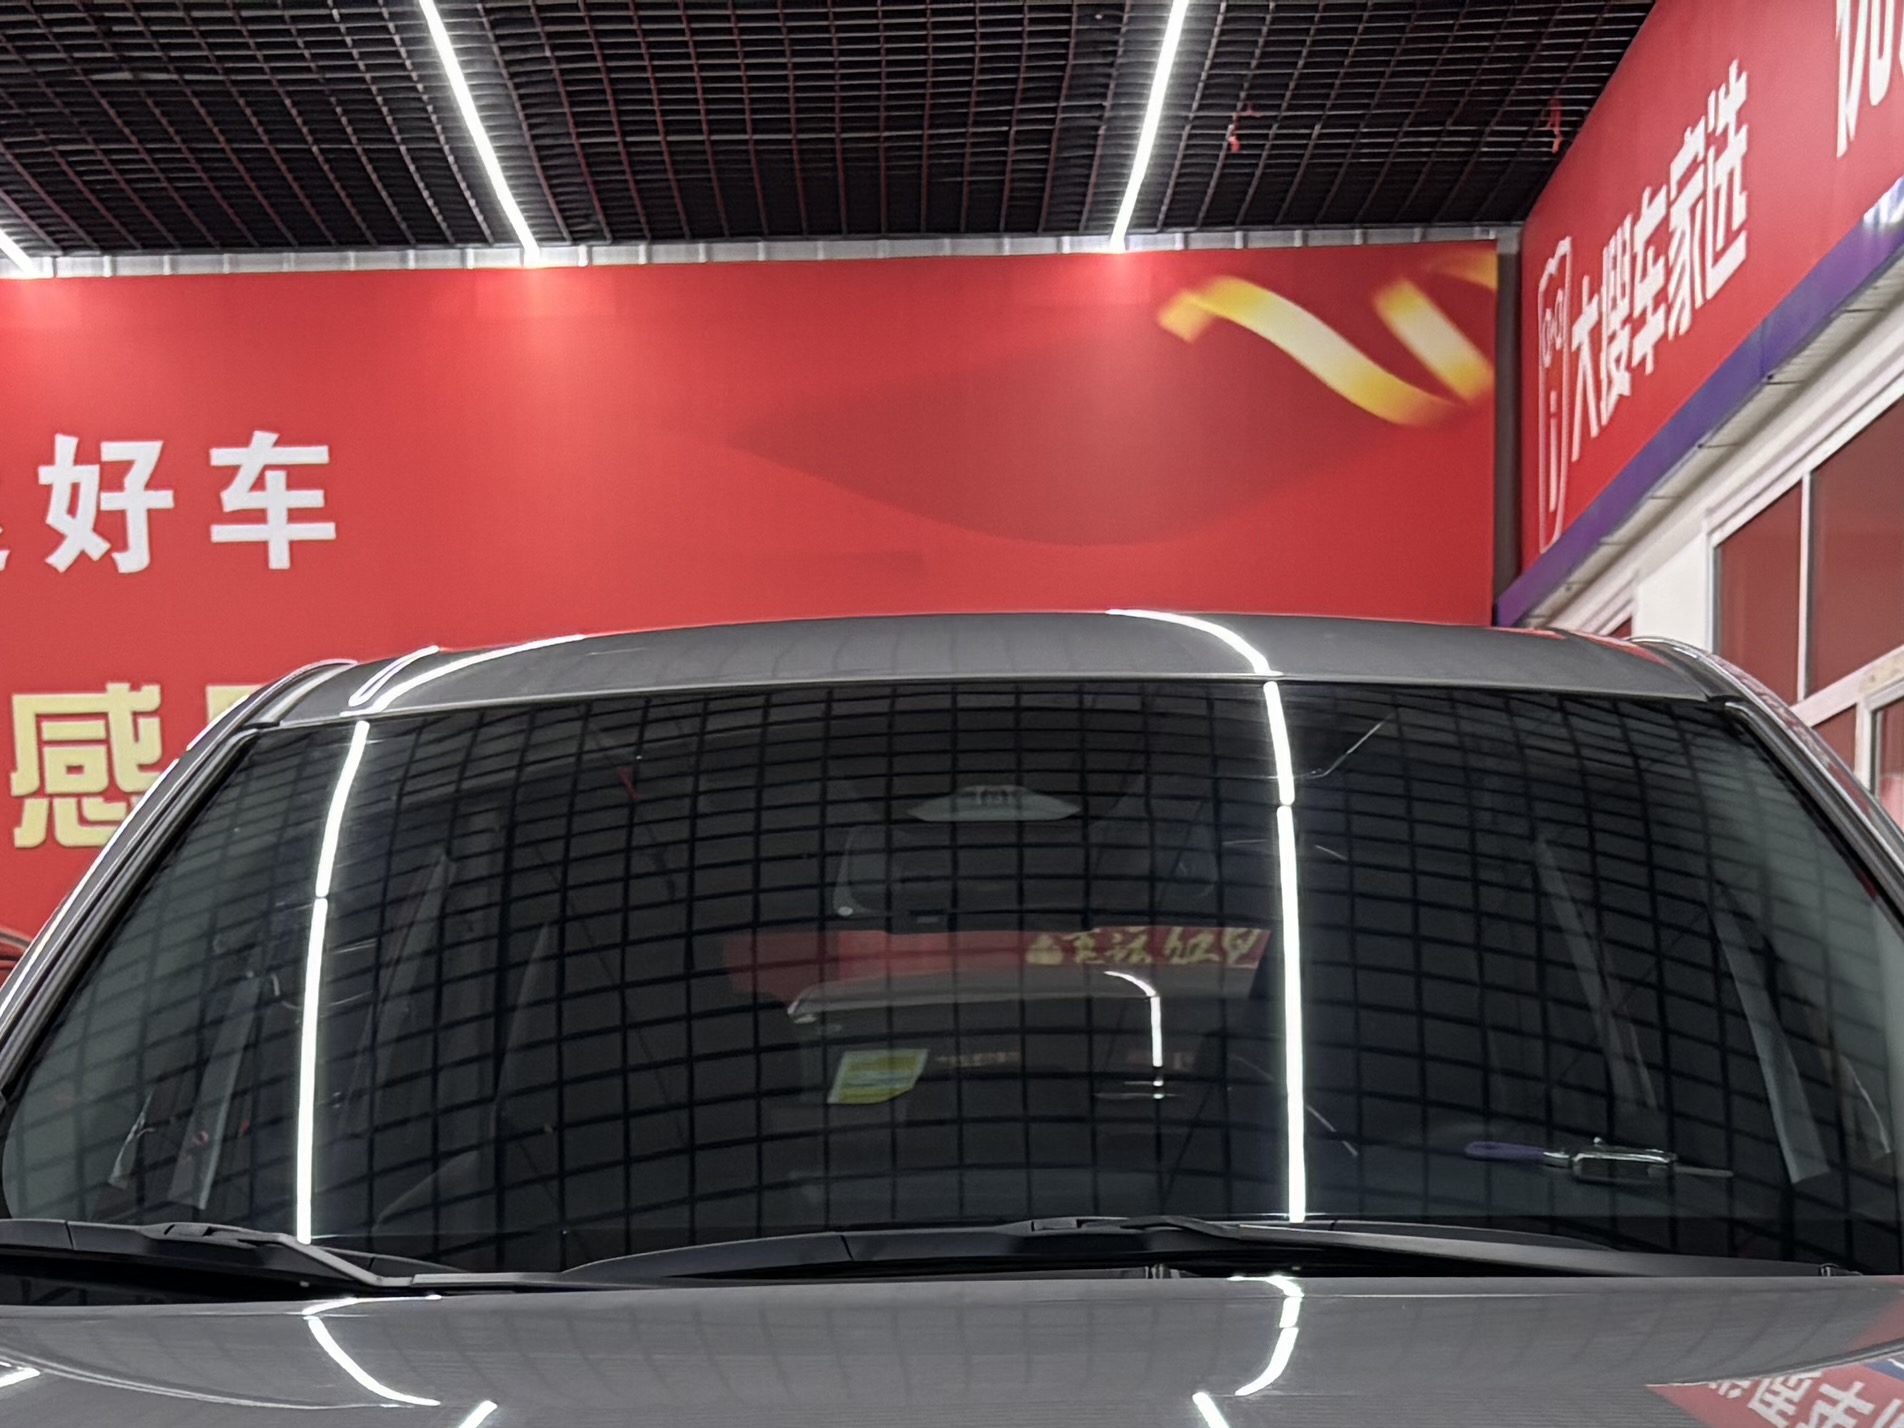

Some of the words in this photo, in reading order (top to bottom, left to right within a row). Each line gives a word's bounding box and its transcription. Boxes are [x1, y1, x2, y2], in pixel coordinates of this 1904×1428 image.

[1571, 59, 1748, 462] 大搜车家选
